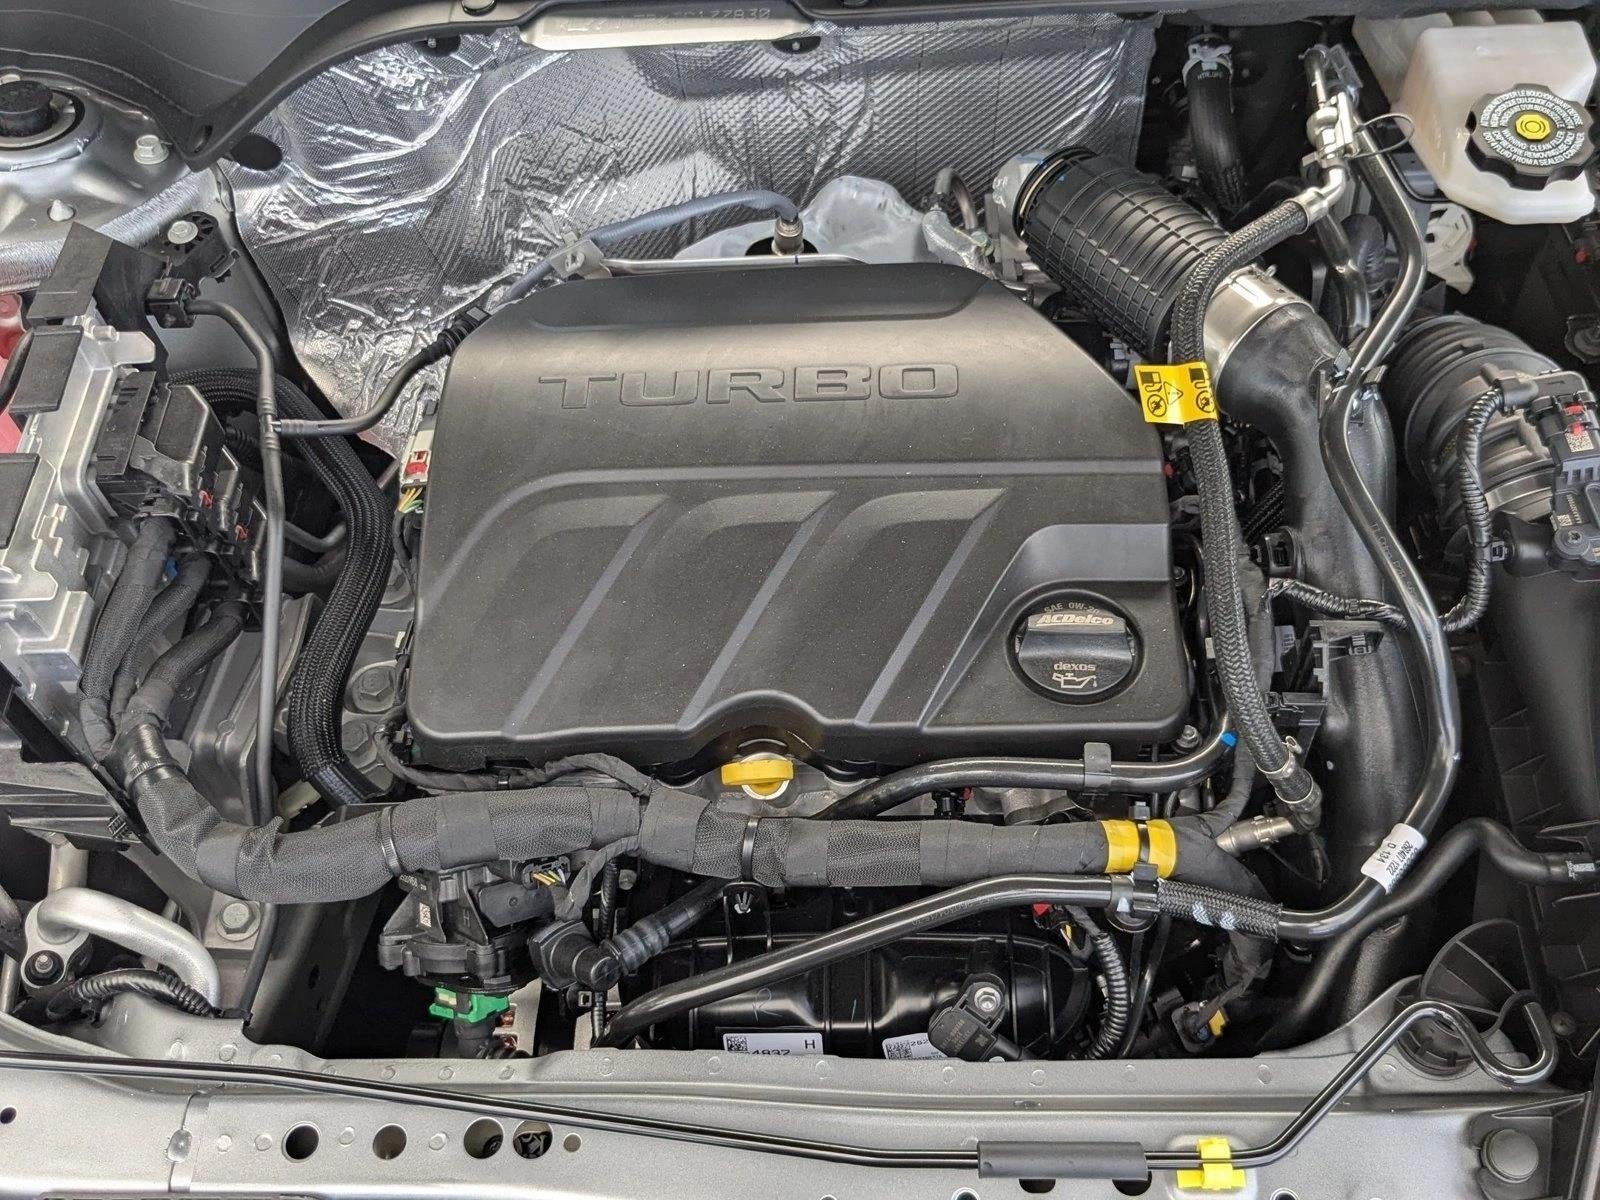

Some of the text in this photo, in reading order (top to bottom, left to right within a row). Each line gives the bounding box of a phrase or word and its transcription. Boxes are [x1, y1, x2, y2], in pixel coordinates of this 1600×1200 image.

[1529, 142, 1552, 151] CLEAN
[1493, 144, 1512, 158] FLUID
[1510, 154, 1531, 164] FROM
[1538, 154, 1565, 165] SEALED
[538, 363, 961, 410] TURBO
[1044, 602, 1063, 612] SAE
[1036, 613, 1114, 626] ACDelco
[1053, 662, 1096, 671] dexos
[804, 1040, 816, 1049] H
